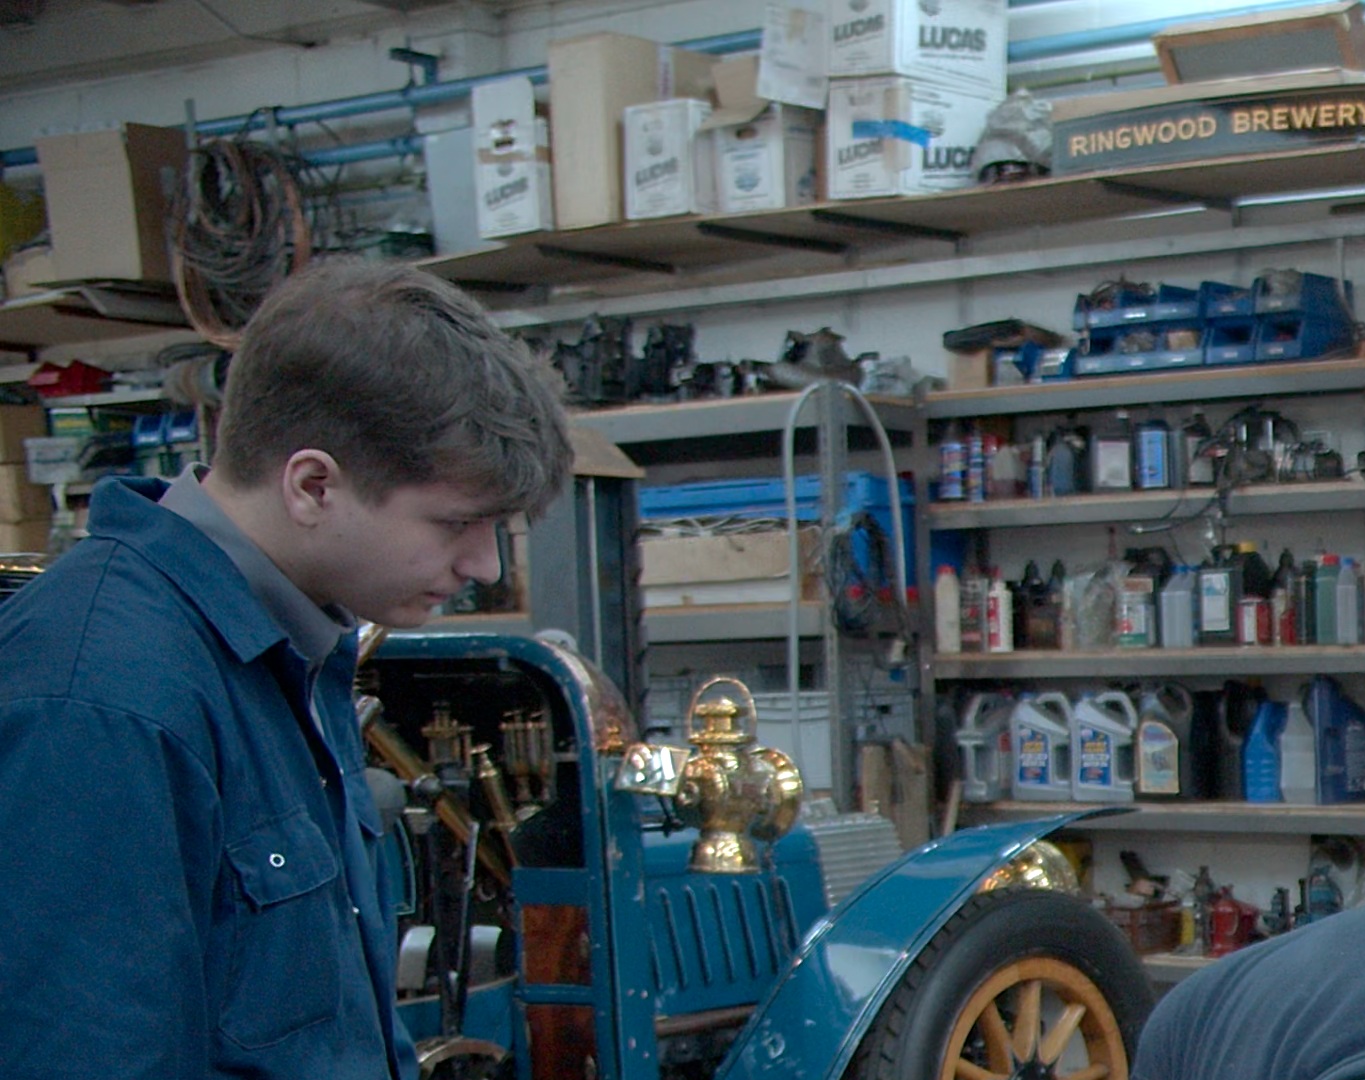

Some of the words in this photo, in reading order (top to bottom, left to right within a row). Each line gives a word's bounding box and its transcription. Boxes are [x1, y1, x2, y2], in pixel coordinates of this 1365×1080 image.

[834, 15, 884, 41] LUCAS
[919, 25, 986, 51] LUCAS
[1070, 116, 1216, 158] RINGWOOD
[923, 147, 974, 170] LUCA
